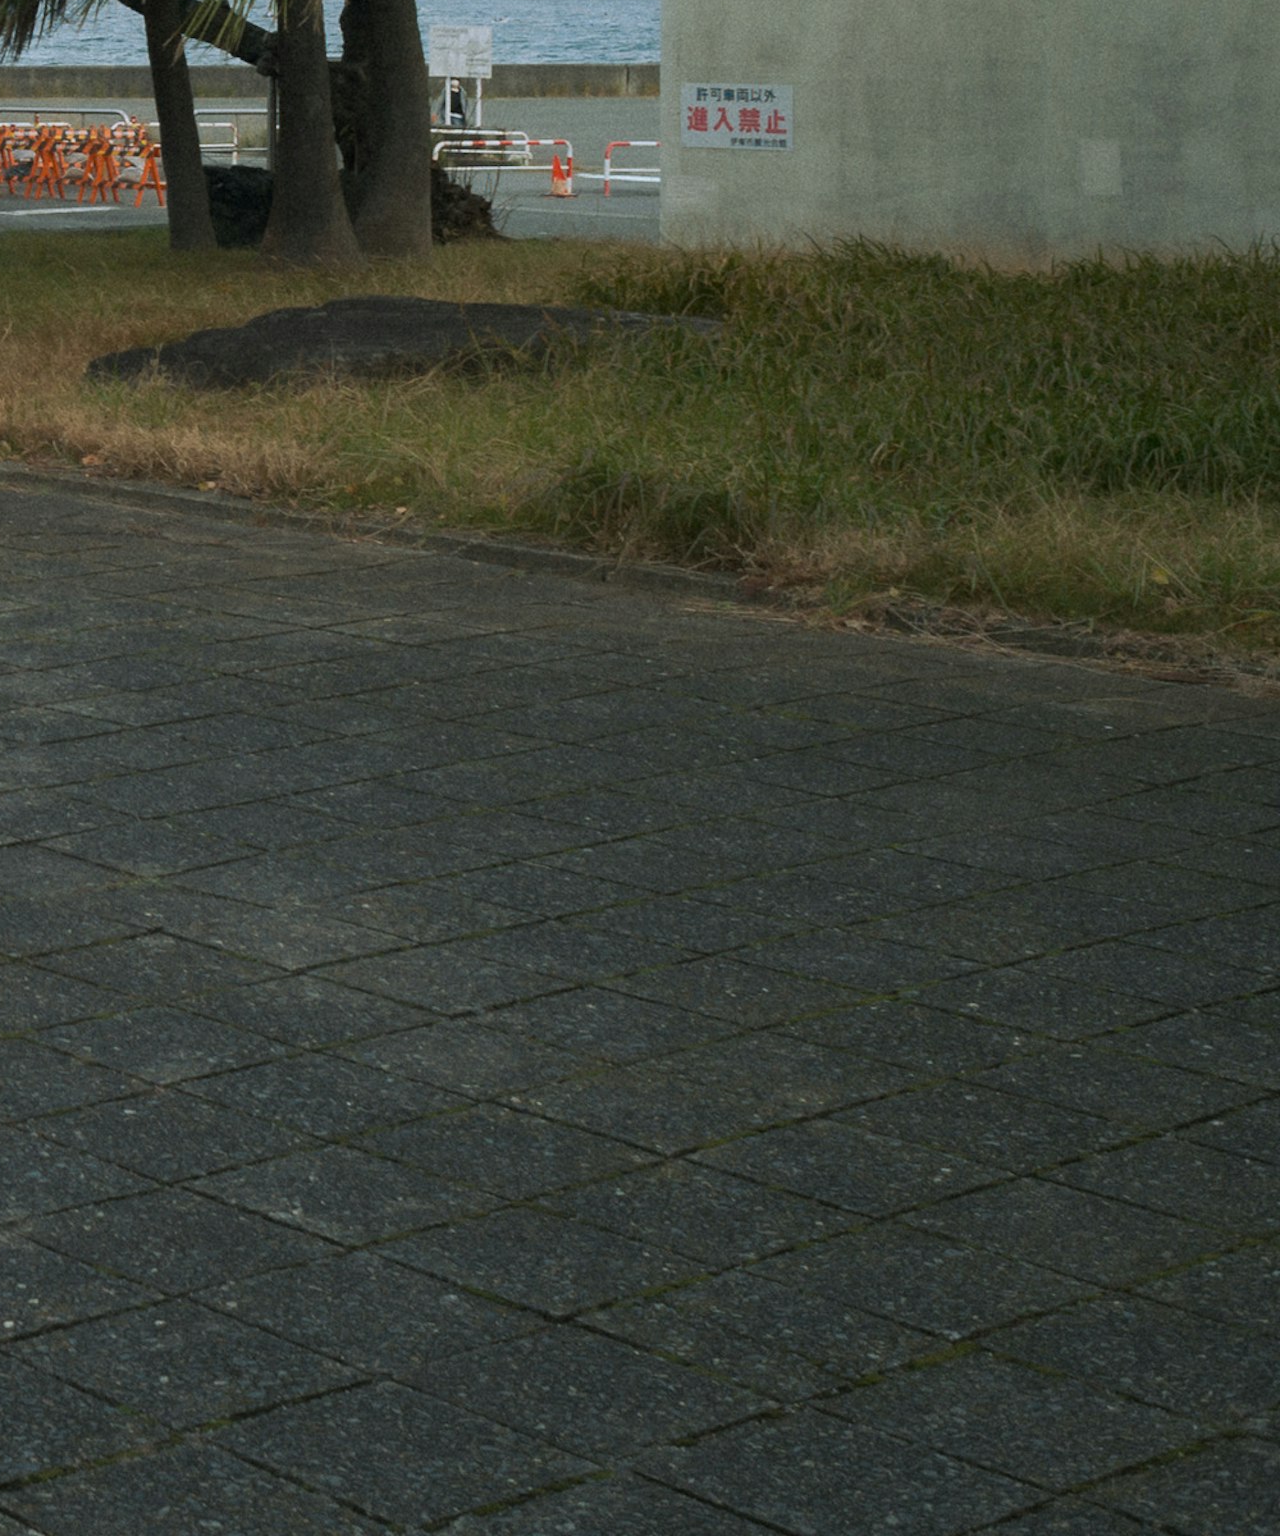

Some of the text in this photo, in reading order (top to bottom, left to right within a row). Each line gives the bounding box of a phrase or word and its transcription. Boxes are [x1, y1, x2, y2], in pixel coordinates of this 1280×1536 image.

[696, 87, 776, 103] 許可車両以外
[687, 106, 787, 135] 進入禁止
